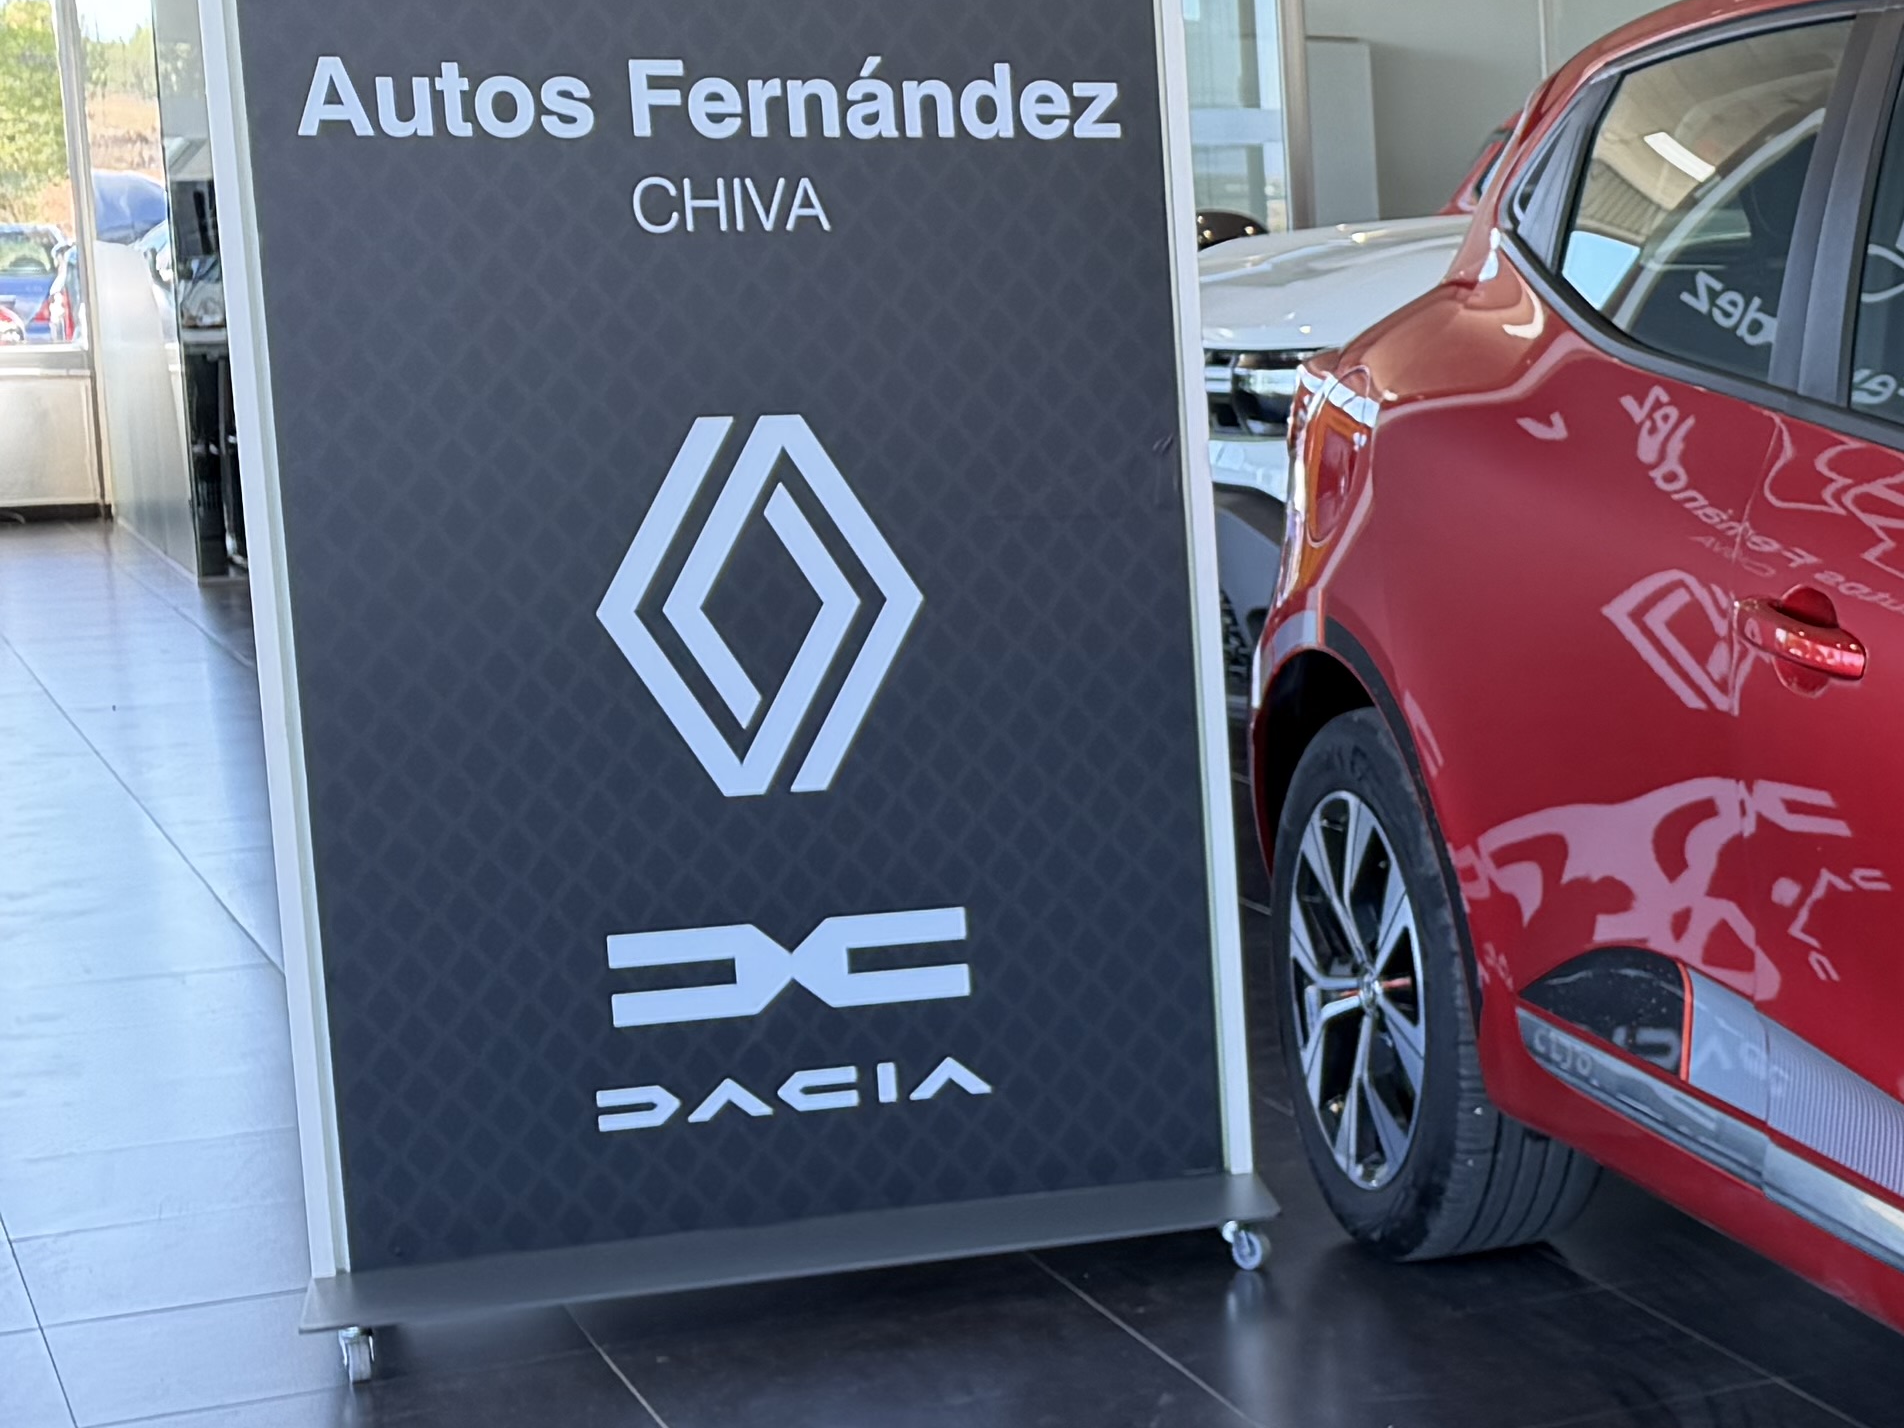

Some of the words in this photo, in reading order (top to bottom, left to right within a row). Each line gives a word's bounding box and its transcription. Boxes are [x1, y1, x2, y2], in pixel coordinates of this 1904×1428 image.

[297, 55, 595, 139] Autos
[629, 55, 1121, 139] Fernández
[631, 176, 831, 233] CHIVA
[1533, 1028, 1593, 1076] CLIO
[596, 1056, 993, 1132] DACIA
